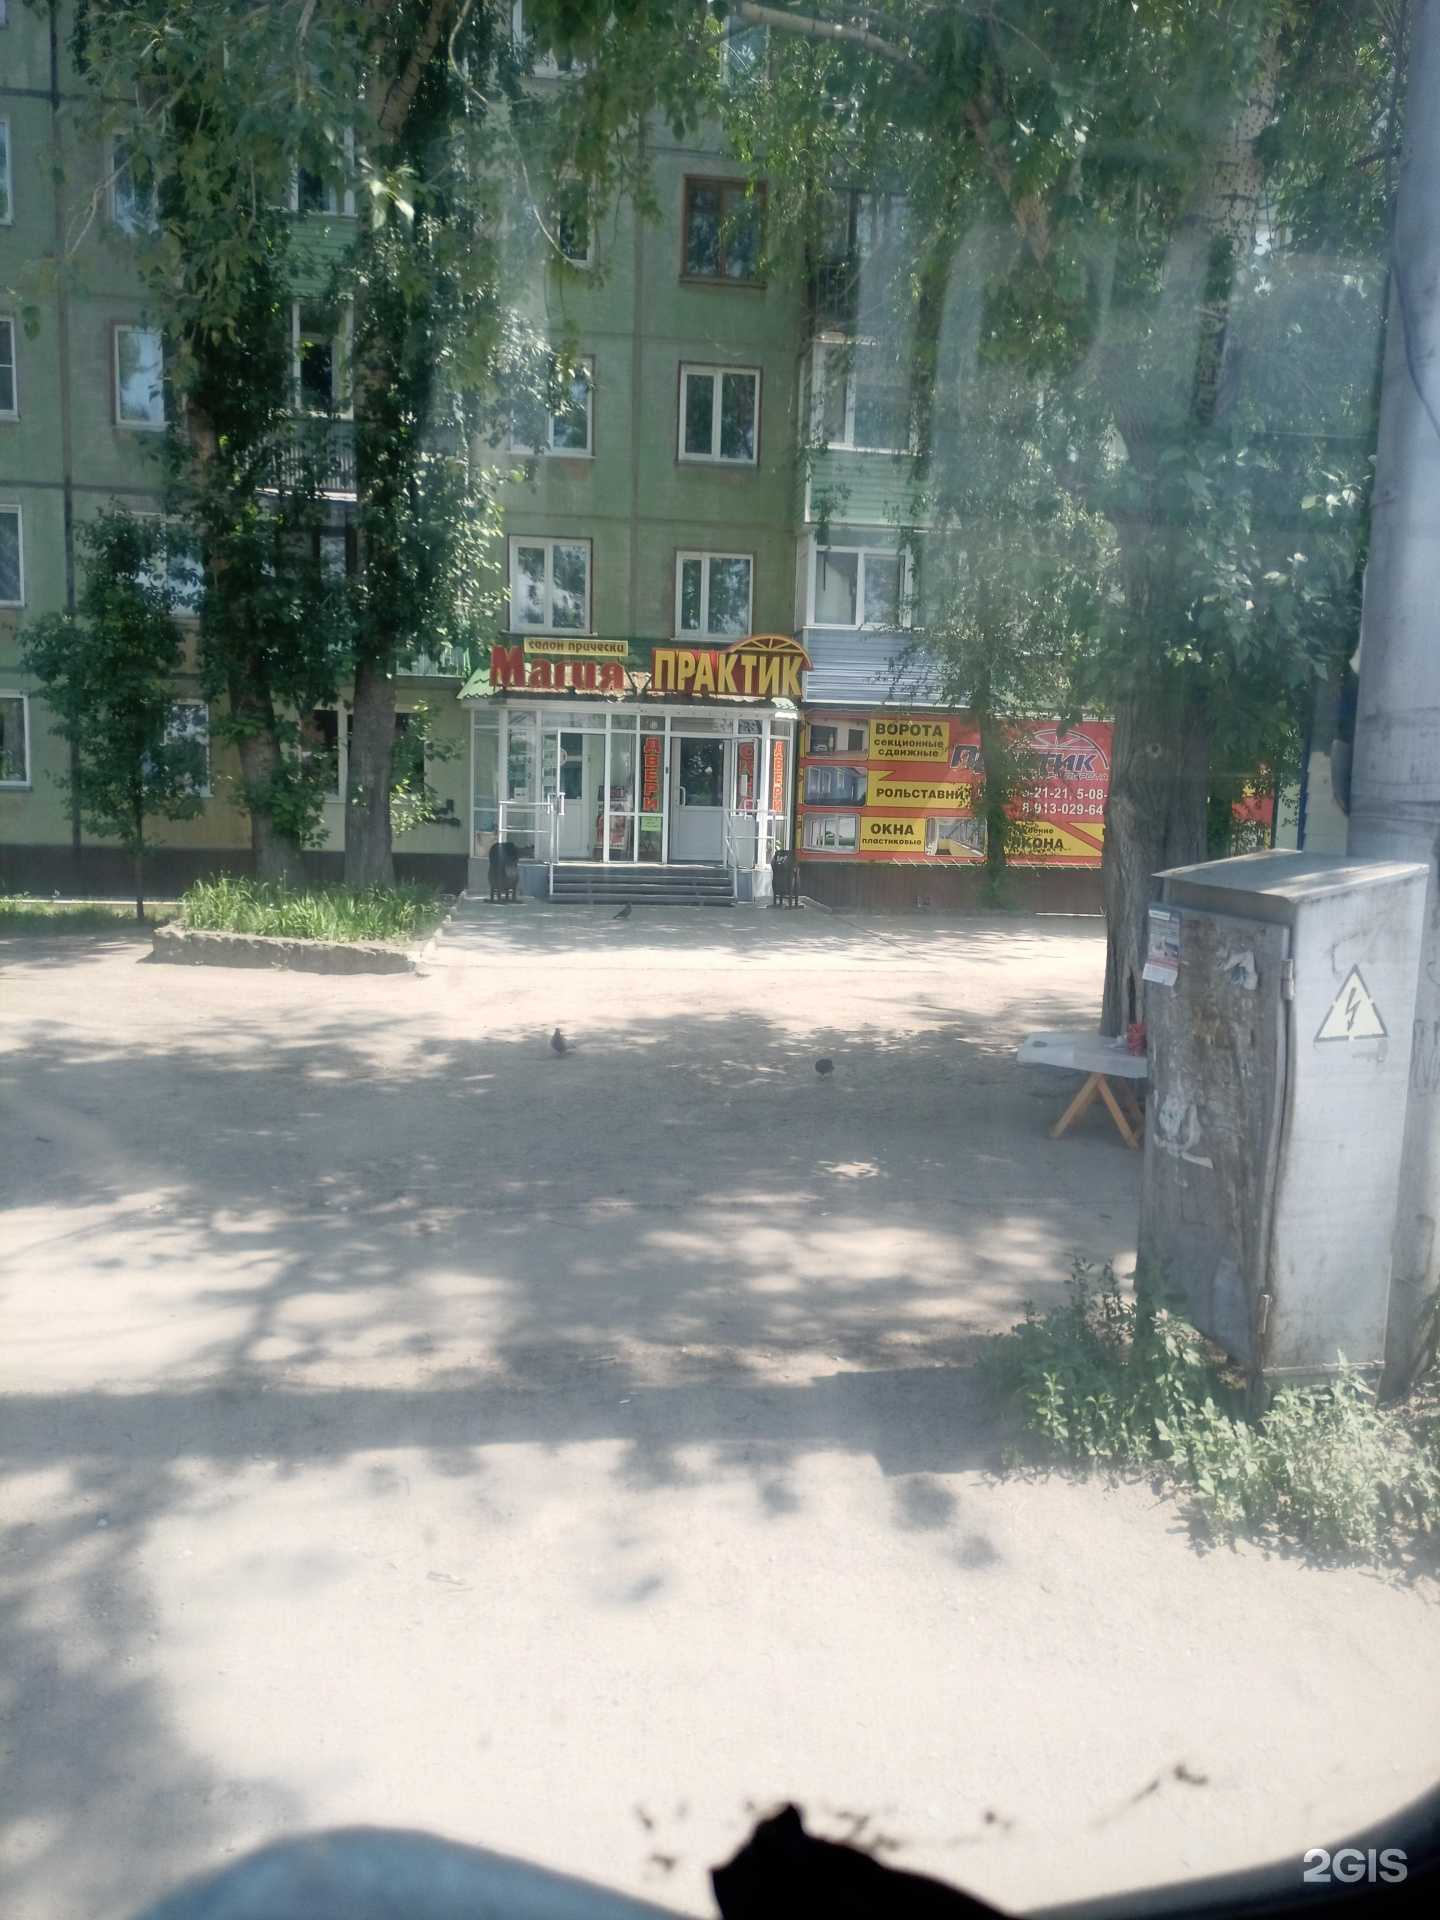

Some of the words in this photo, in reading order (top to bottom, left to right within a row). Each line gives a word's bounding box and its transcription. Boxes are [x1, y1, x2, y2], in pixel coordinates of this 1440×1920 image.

[489, 645, 625, 691] Магия
[653, 649, 804, 696] ПРАКТИК
[875, 723, 943, 736] ВОРОТА
[643, 737, 661, 811] ДВЕРИ
[870, 823, 914, 835] ОКНА
